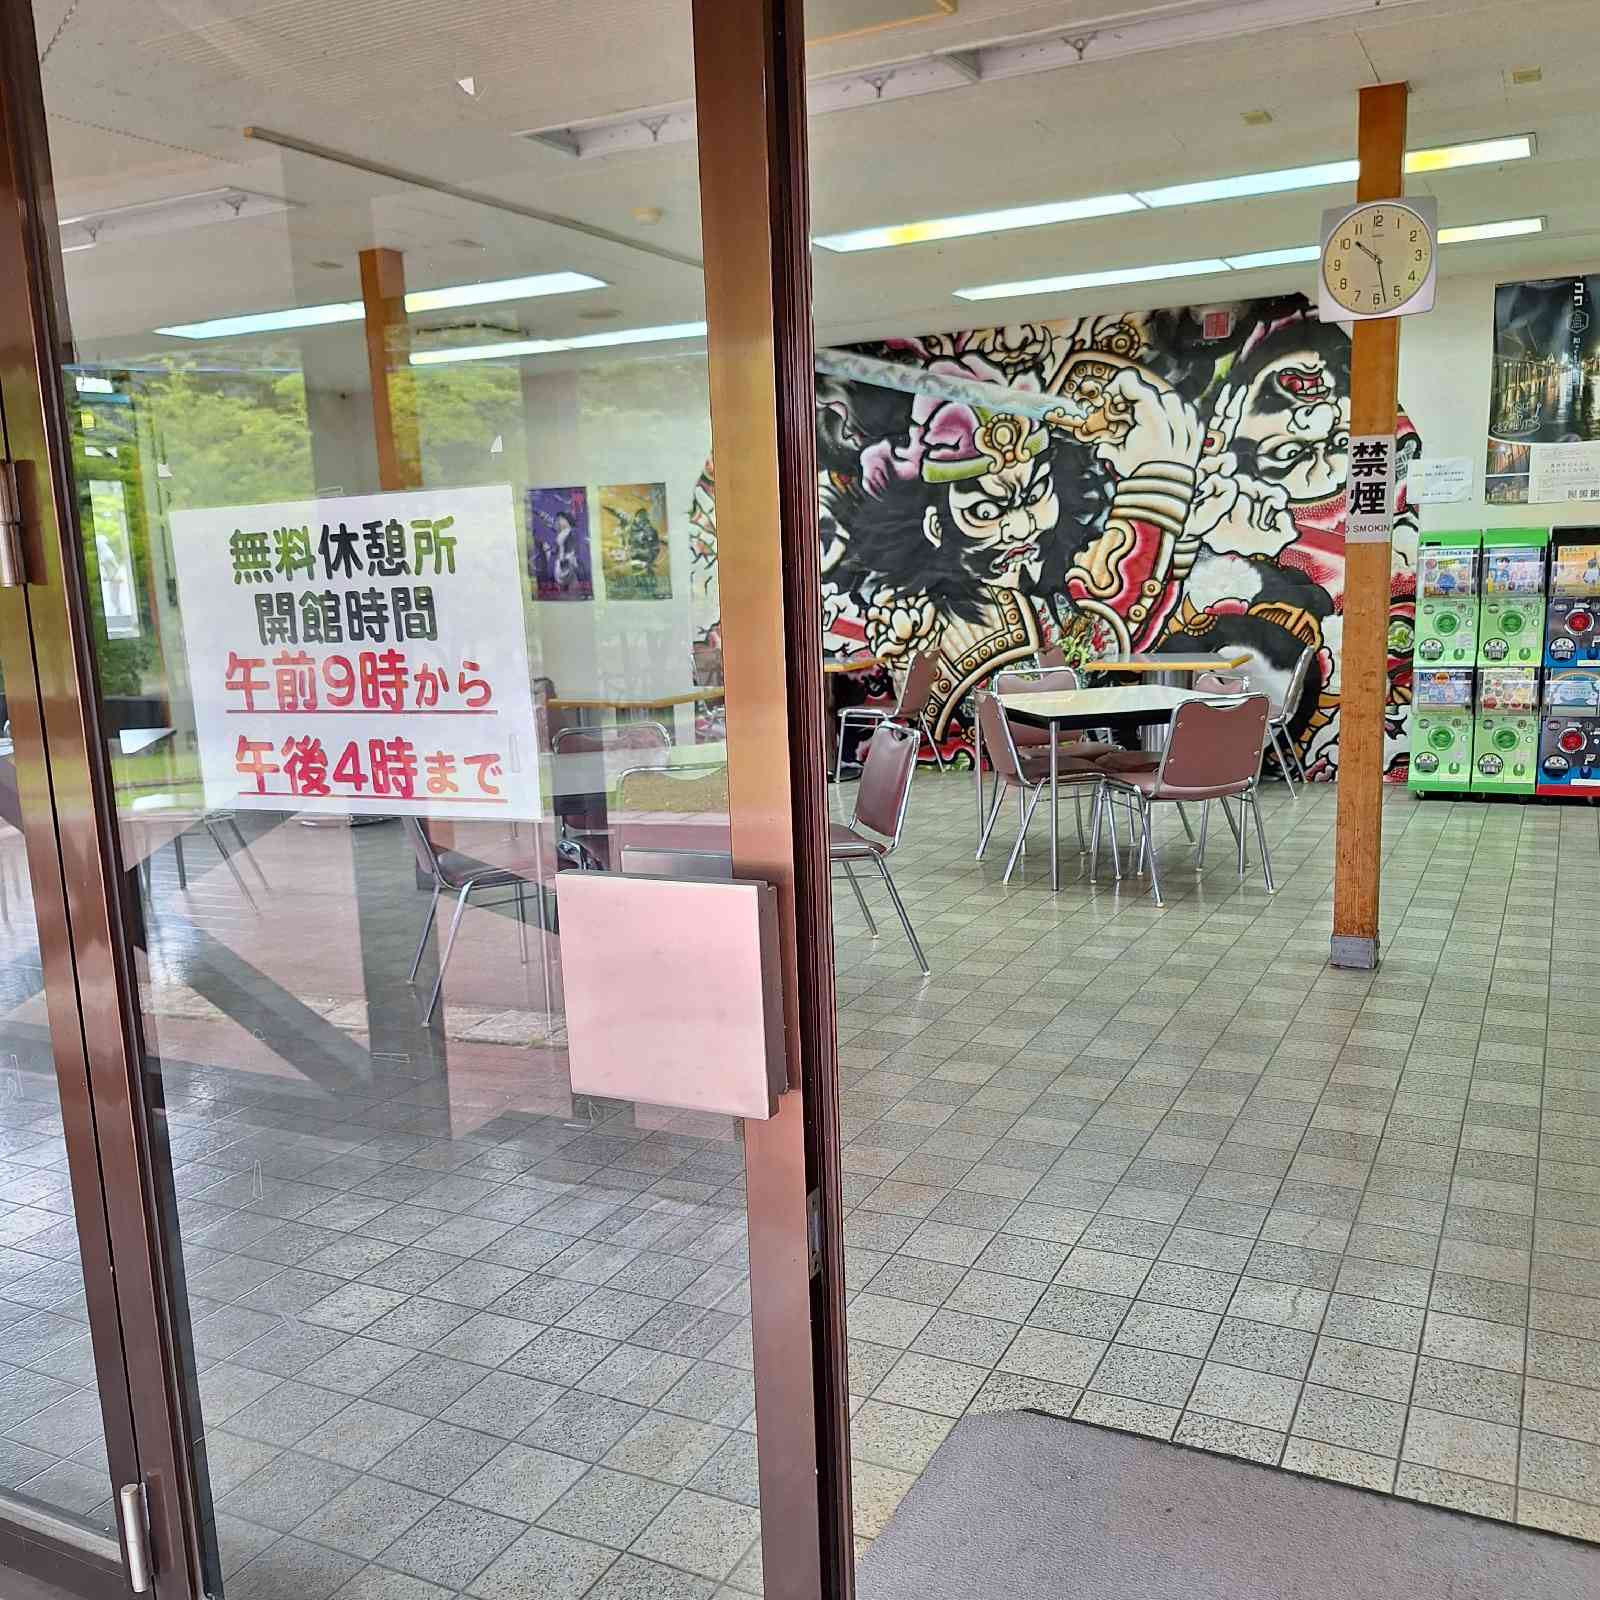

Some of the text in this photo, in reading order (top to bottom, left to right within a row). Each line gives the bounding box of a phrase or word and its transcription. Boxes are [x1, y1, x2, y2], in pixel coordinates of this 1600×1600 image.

[1374, 215, 1384, 227] 12
[1355, 223, 1363, 236] 11
[1409, 230, 1417, 242] 2
[1340, 238, 1351, 250] 10
[1415, 249, 1422, 261] 3
[1334, 259, 1341, 271] 9
[1408, 270, 1416, 281] 4
[1340, 278, 1347, 290] 8
[1353, 290, 1361, 302] 7
[1372, 293, 1380, 305] 6
[1350, 441, 1388, 516] 禁煙
[228, 517, 458, 584] 無料休憩所
[254, 586, 438, 645] 開館時間
[225, 649, 493, 712] 午前9時から
[235, 735, 504, 799] 午後4時まで
